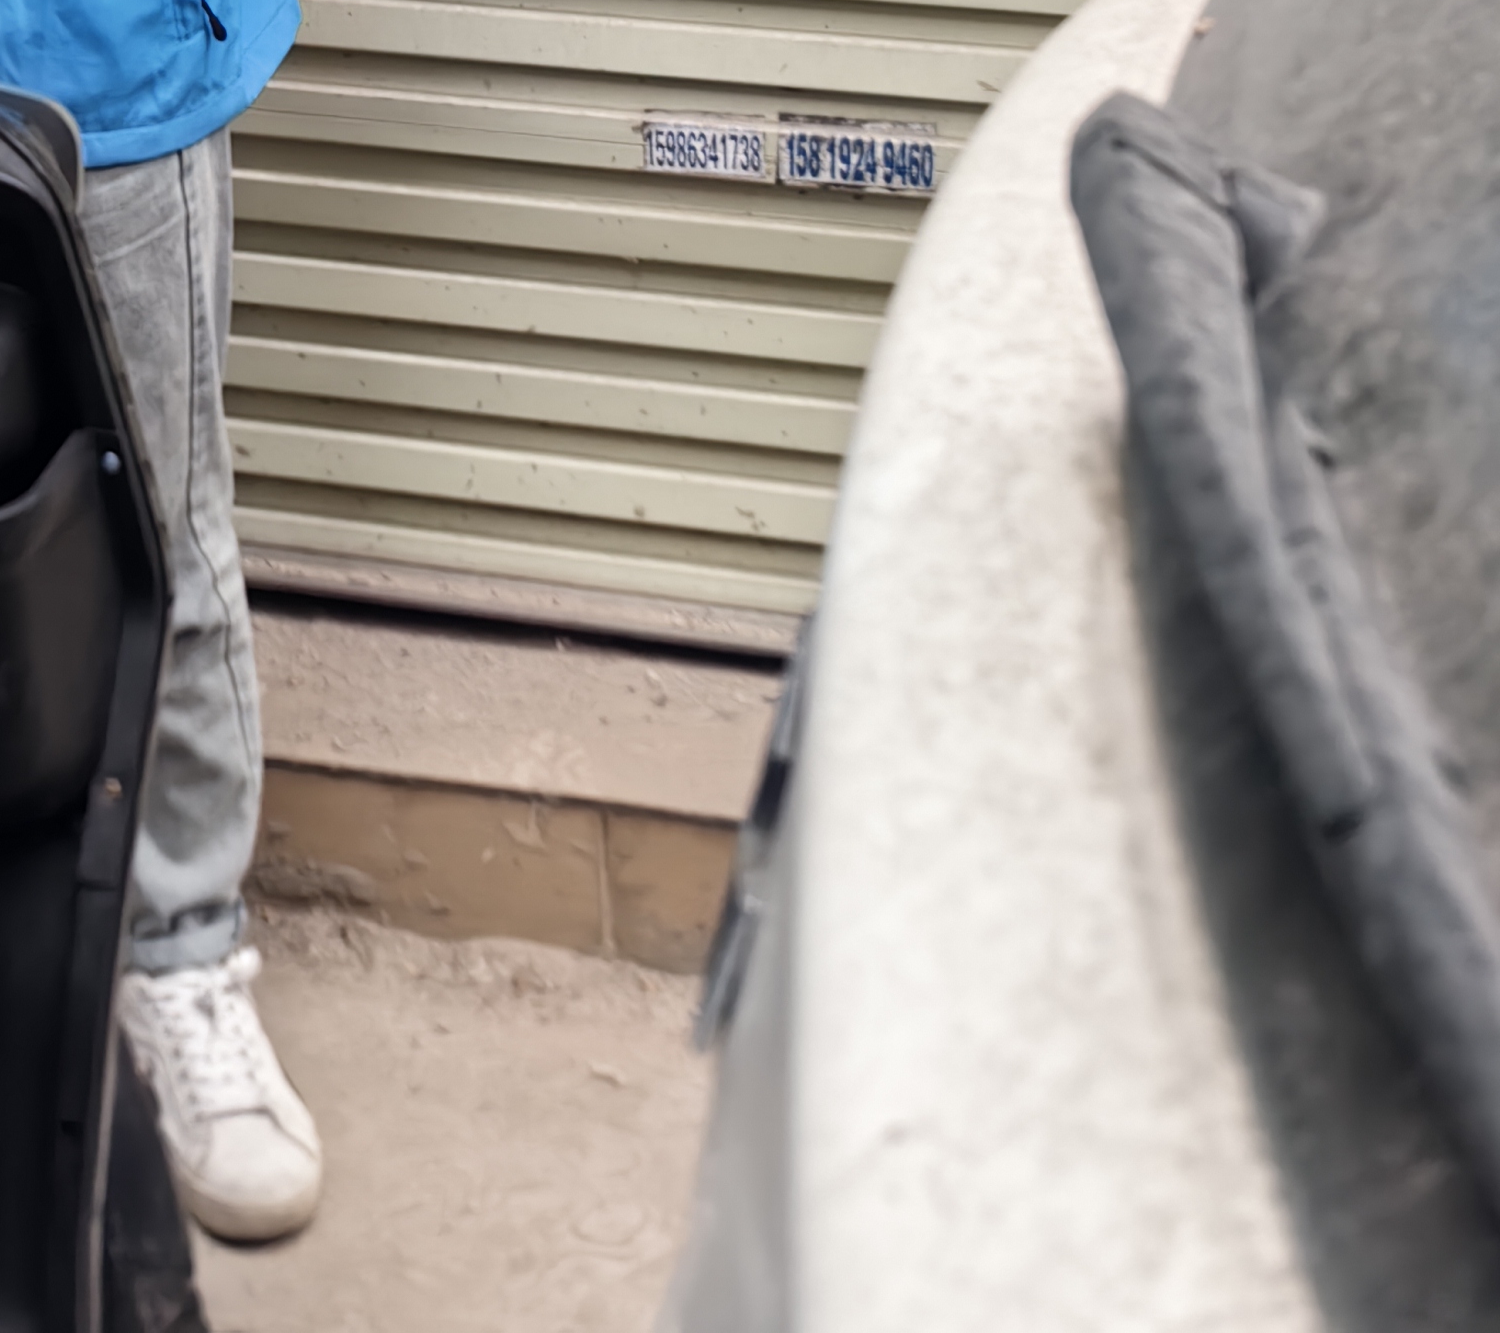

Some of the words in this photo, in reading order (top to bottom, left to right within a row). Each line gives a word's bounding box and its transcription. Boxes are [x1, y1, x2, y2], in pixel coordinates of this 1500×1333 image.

[645, 130, 762, 172] 15986341738
[787, 132, 821, 178] 158
[826, 135, 877, 182] 1924
[882, 138, 935, 188] 9460
